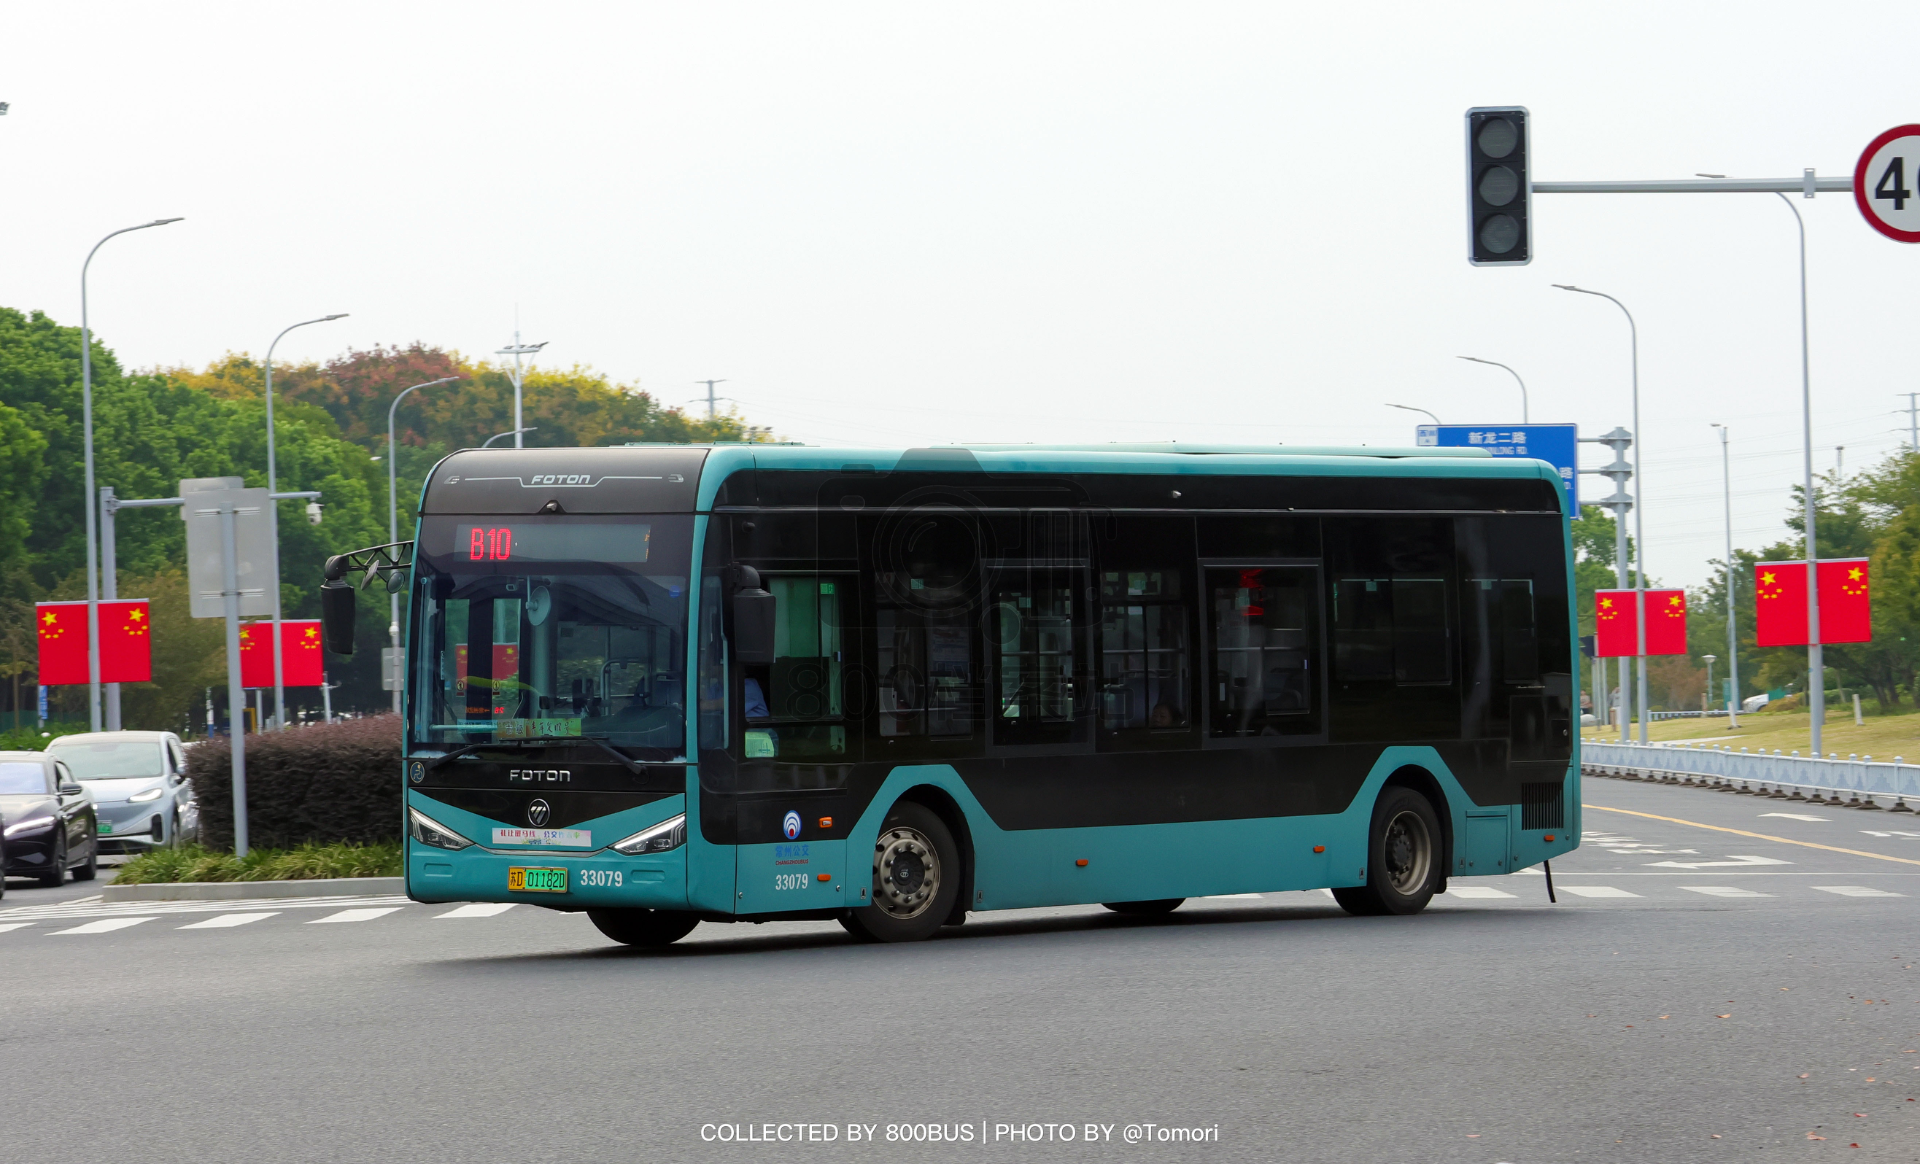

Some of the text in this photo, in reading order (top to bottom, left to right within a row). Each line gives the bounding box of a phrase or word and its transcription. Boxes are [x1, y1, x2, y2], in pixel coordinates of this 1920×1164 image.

[1875, 156, 1920, 210] 4
[1468, 431, 1527, 444] 新龙二路
[531, 474, 591, 484] FOTON
[470, 528, 512, 560] B10
[510, 770, 571, 782] FOTON
[775, 844, 809, 857] 常州公交
[580, 869, 623, 887] 33079
[775, 873, 809, 890] 33079
